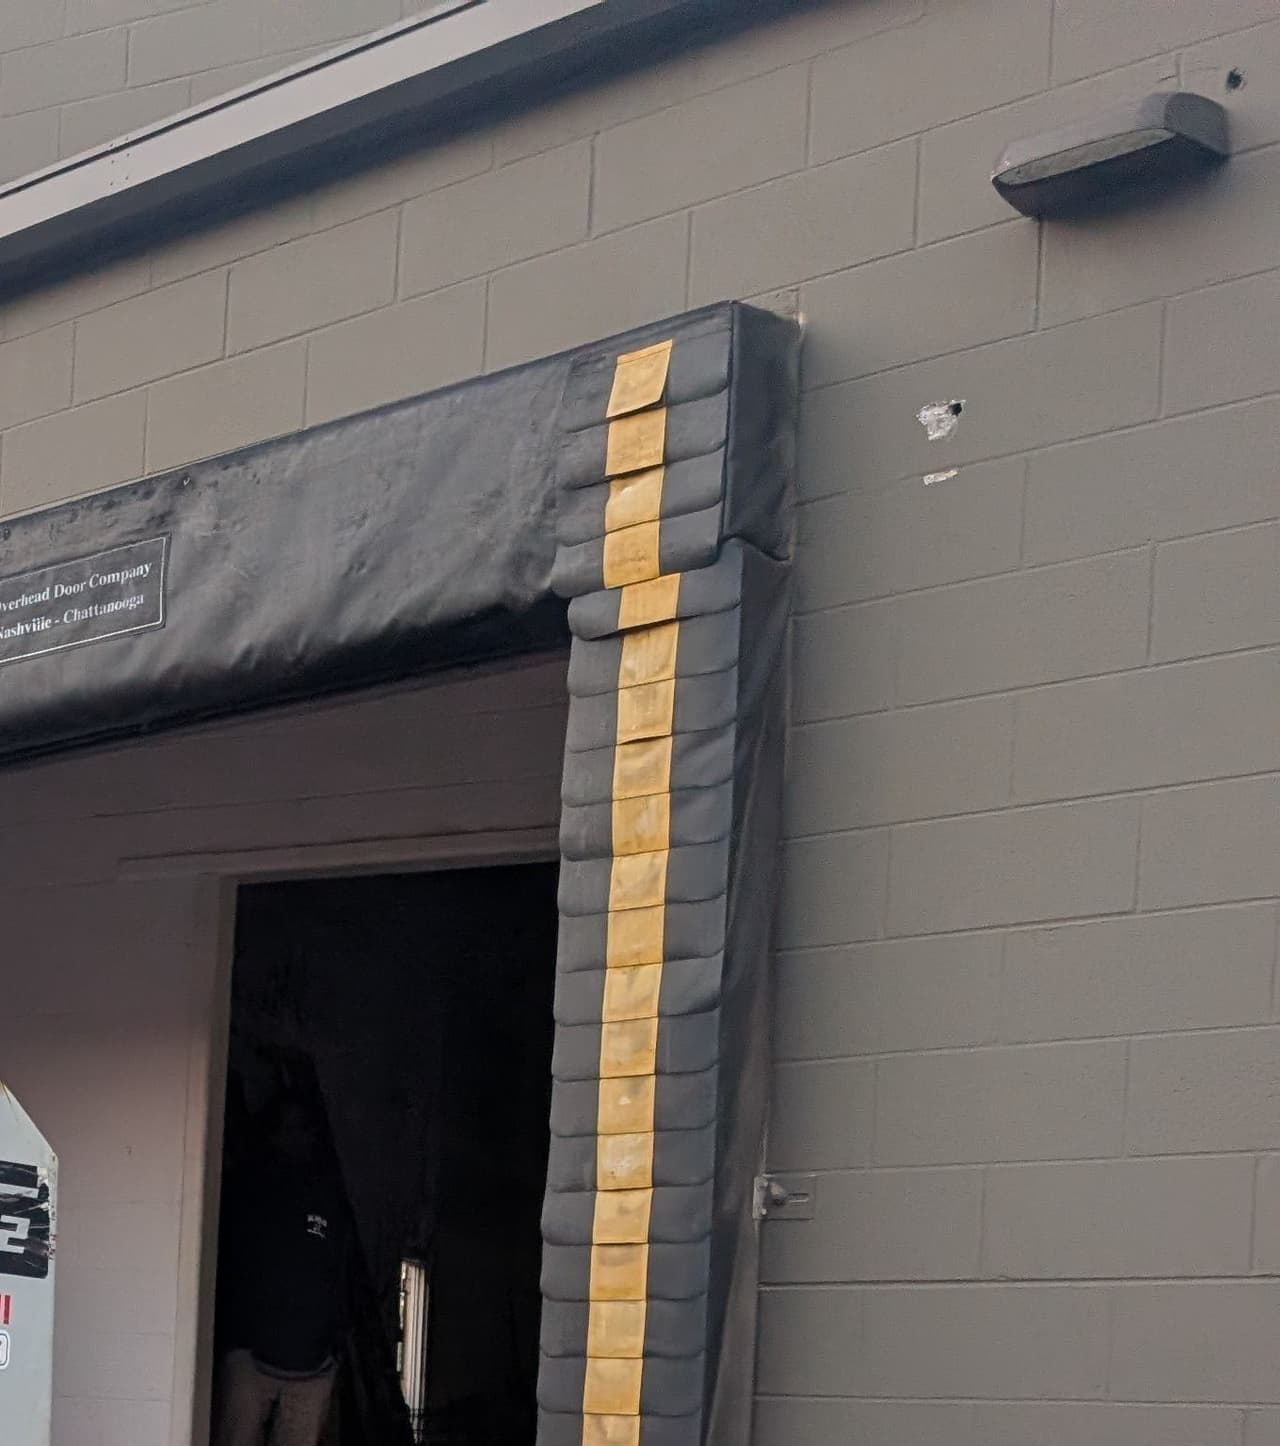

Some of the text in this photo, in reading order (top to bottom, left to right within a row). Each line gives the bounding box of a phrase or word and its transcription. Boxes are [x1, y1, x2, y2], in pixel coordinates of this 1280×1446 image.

[54, 582, 87, 598] Door
[89, 562, 153, 588] Company
[63, 594, 144, 624] Chattanooga
